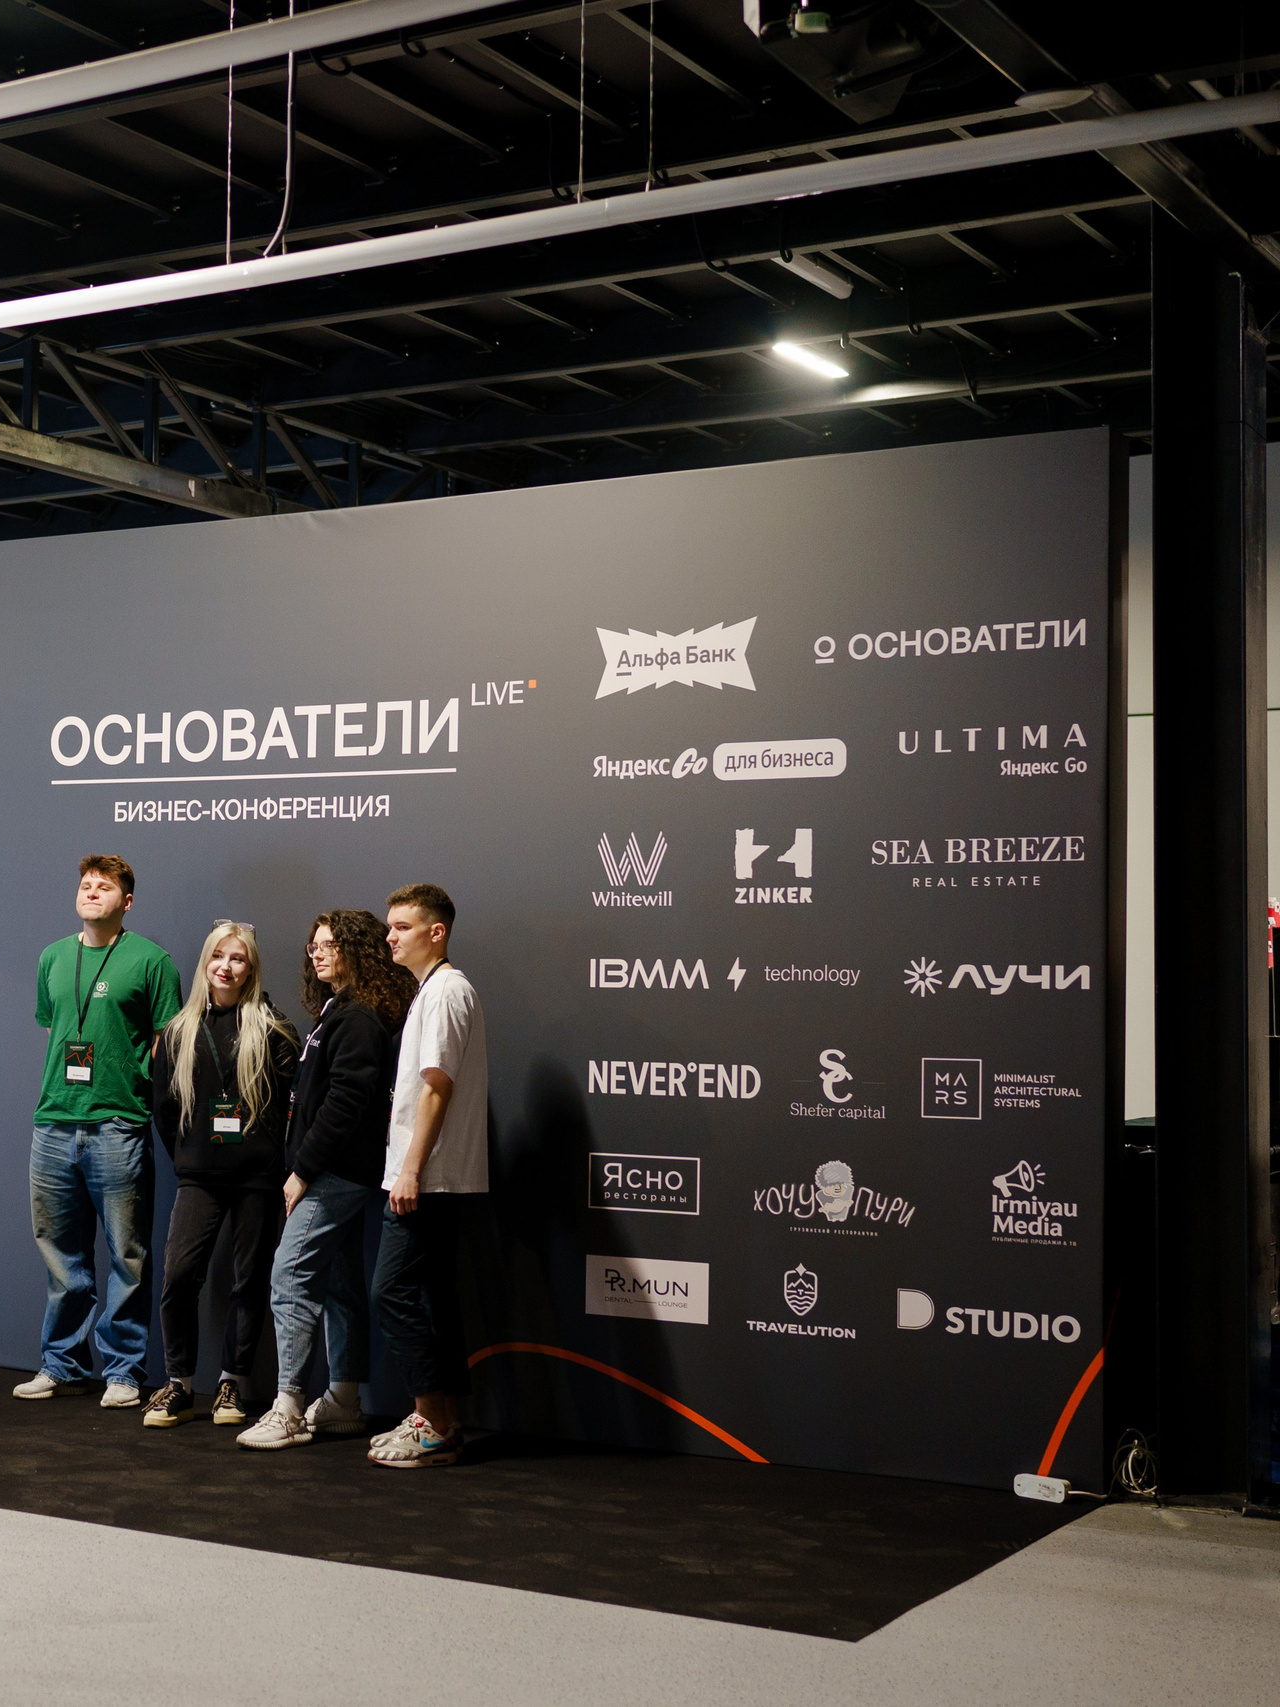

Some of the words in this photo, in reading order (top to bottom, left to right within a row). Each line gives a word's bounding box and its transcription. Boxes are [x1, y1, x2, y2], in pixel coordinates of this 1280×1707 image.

[848, 619, 1085, 660] ОСНОВАТЕЛИ
[617, 650, 680, 670] Альфа
[686, 646, 735, 664] Банк
[51, 698, 459, 767] ОСНОВАТЕЛИ
[472, 681, 524, 705] LIVE
[899, 724, 1086, 754] ULTIMA
[594, 756, 670, 779] Яндекс
[672, 748, 707, 778] Go
[725, 755, 756, 772] для
[762, 749, 833, 768] бизнеса
[1001, 760, 1058, 777] Яндекс
[1065, 757, 1087, 773] Go
[115, 795, 389, 822] БИЗНЕС-КОНФЕРЕНЦИЯ
[872, 840, 934, 865] SEA
[945, 836, 1084, 863] BREEZE
[913, 878, 957, 887] REAL
[972, 876, 1040, 886] ESTATE
[592, 891, 671, 906] Whitewill
[735, 887, 812, 904] ZINKER
[590, 959, 709, 989] IBMM
[765, 965, 860, 986] technology
[995, 1074, 1055, 1083] MINIMALIST
[994, 1086, 1081, 1097] ARCHITECTURAL
[790, 1101, 835, 1118] Shefer
[838, 1105, 886, 1120] capital
[994, 1098, 1040, 1108] SYSTEMS
[604, 1191, 687, 1202] рестораны
[992, 1194, 1078, 1219] Irmiyau
[789, 1226, 830, 1235] ГРУЗИНСКИЙ
[833, 1229, 879, 1237] РЕСТОРАНЧИК
[992, 1214, 1063, 1237] Media
[992, 1236, 1029, 1244] ПУБЛИЧНЫЕ
[1030, 1238, 1062, 1246] ПРОДАЖИ
[604, 1295, 634, 1304] DENTAL
[658, 1300, 689, 1309] LOUNGE
[747, 1321, 855, 1338] TRAVELUTION
[945, 1307, 1080, 1343] STUDIO
